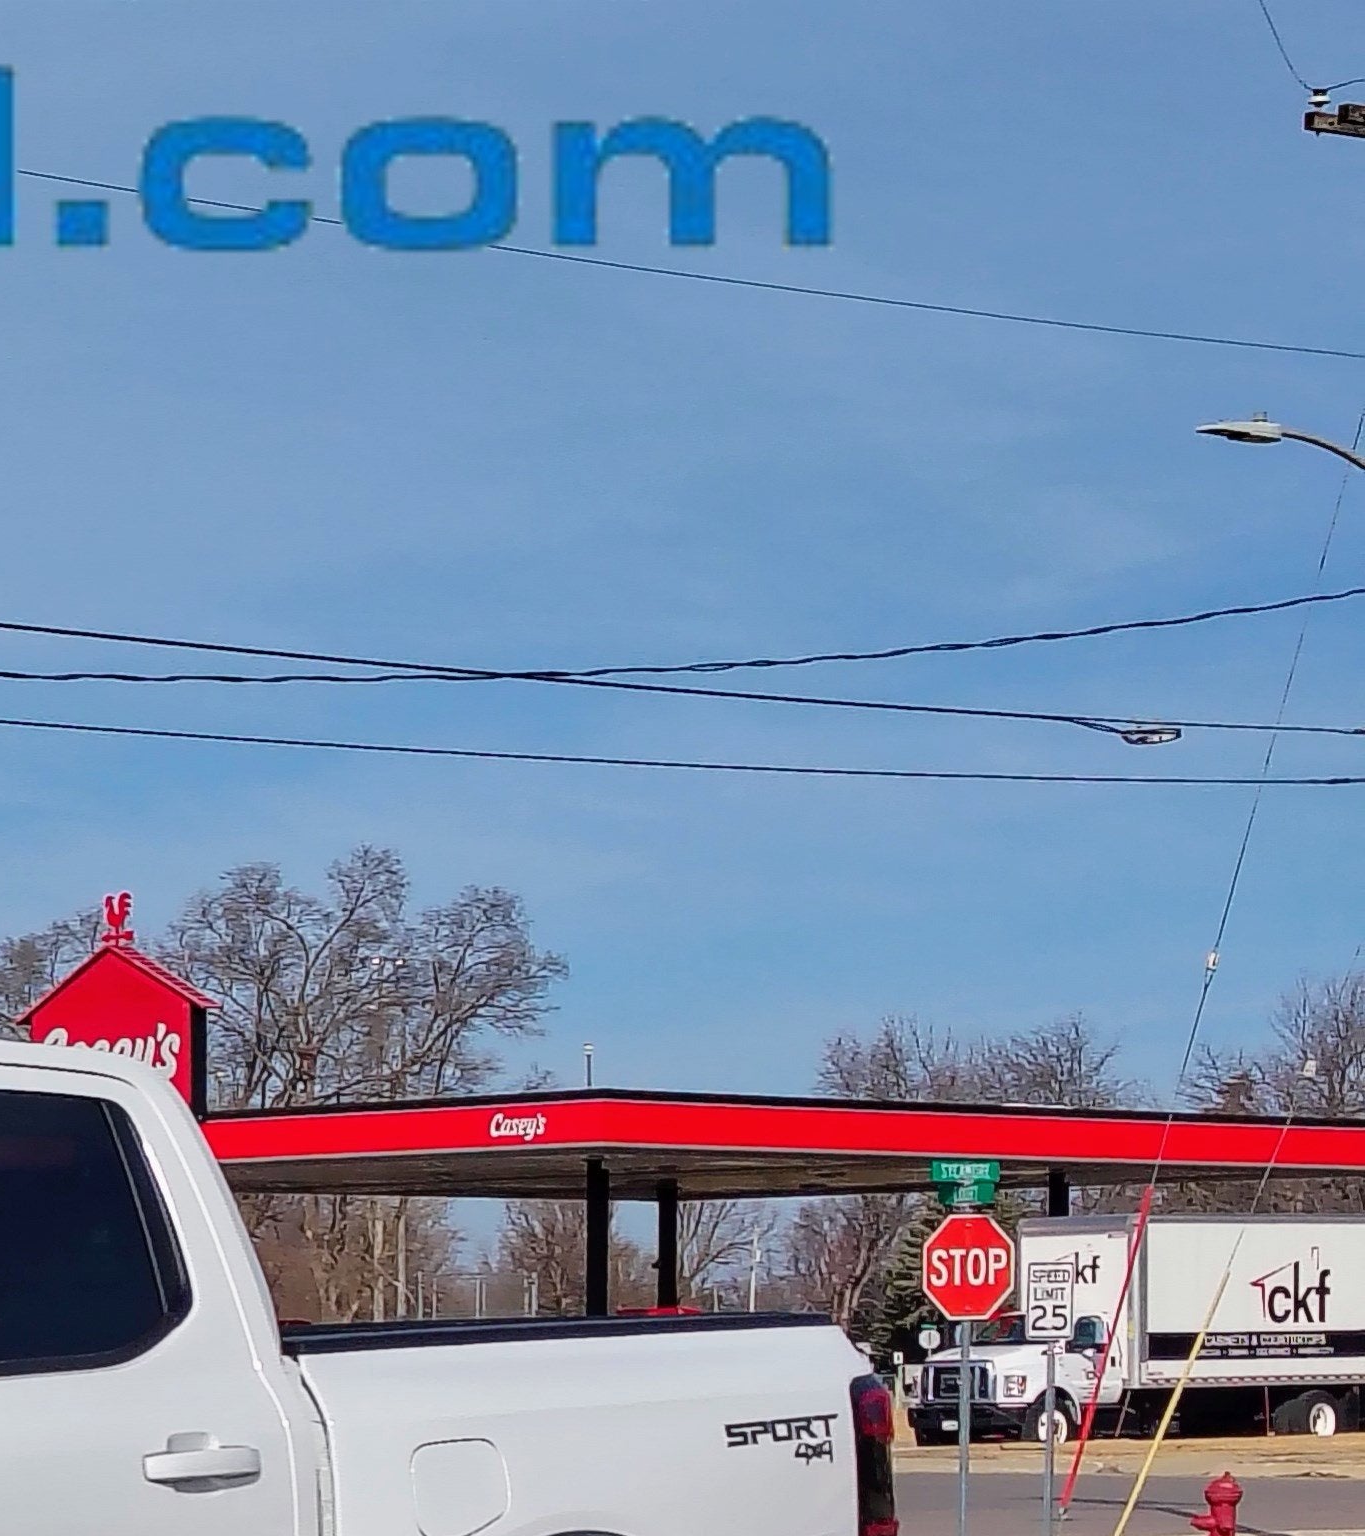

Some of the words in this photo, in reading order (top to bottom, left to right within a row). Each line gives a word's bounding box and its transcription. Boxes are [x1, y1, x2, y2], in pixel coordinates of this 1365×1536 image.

[490, 1112, 548, 1141] Casey's
[929, 1247, 1009, 1287] STOP
[1074, 1251, 1101, 1285] kf
[1033, 1287, 1067, 1302] LIMIT
[1267, 1261, 1331, 1324] ckf
[1030, 1304, 1069, 1332] 25
[725, 1413, 839, 1448] SPORT
